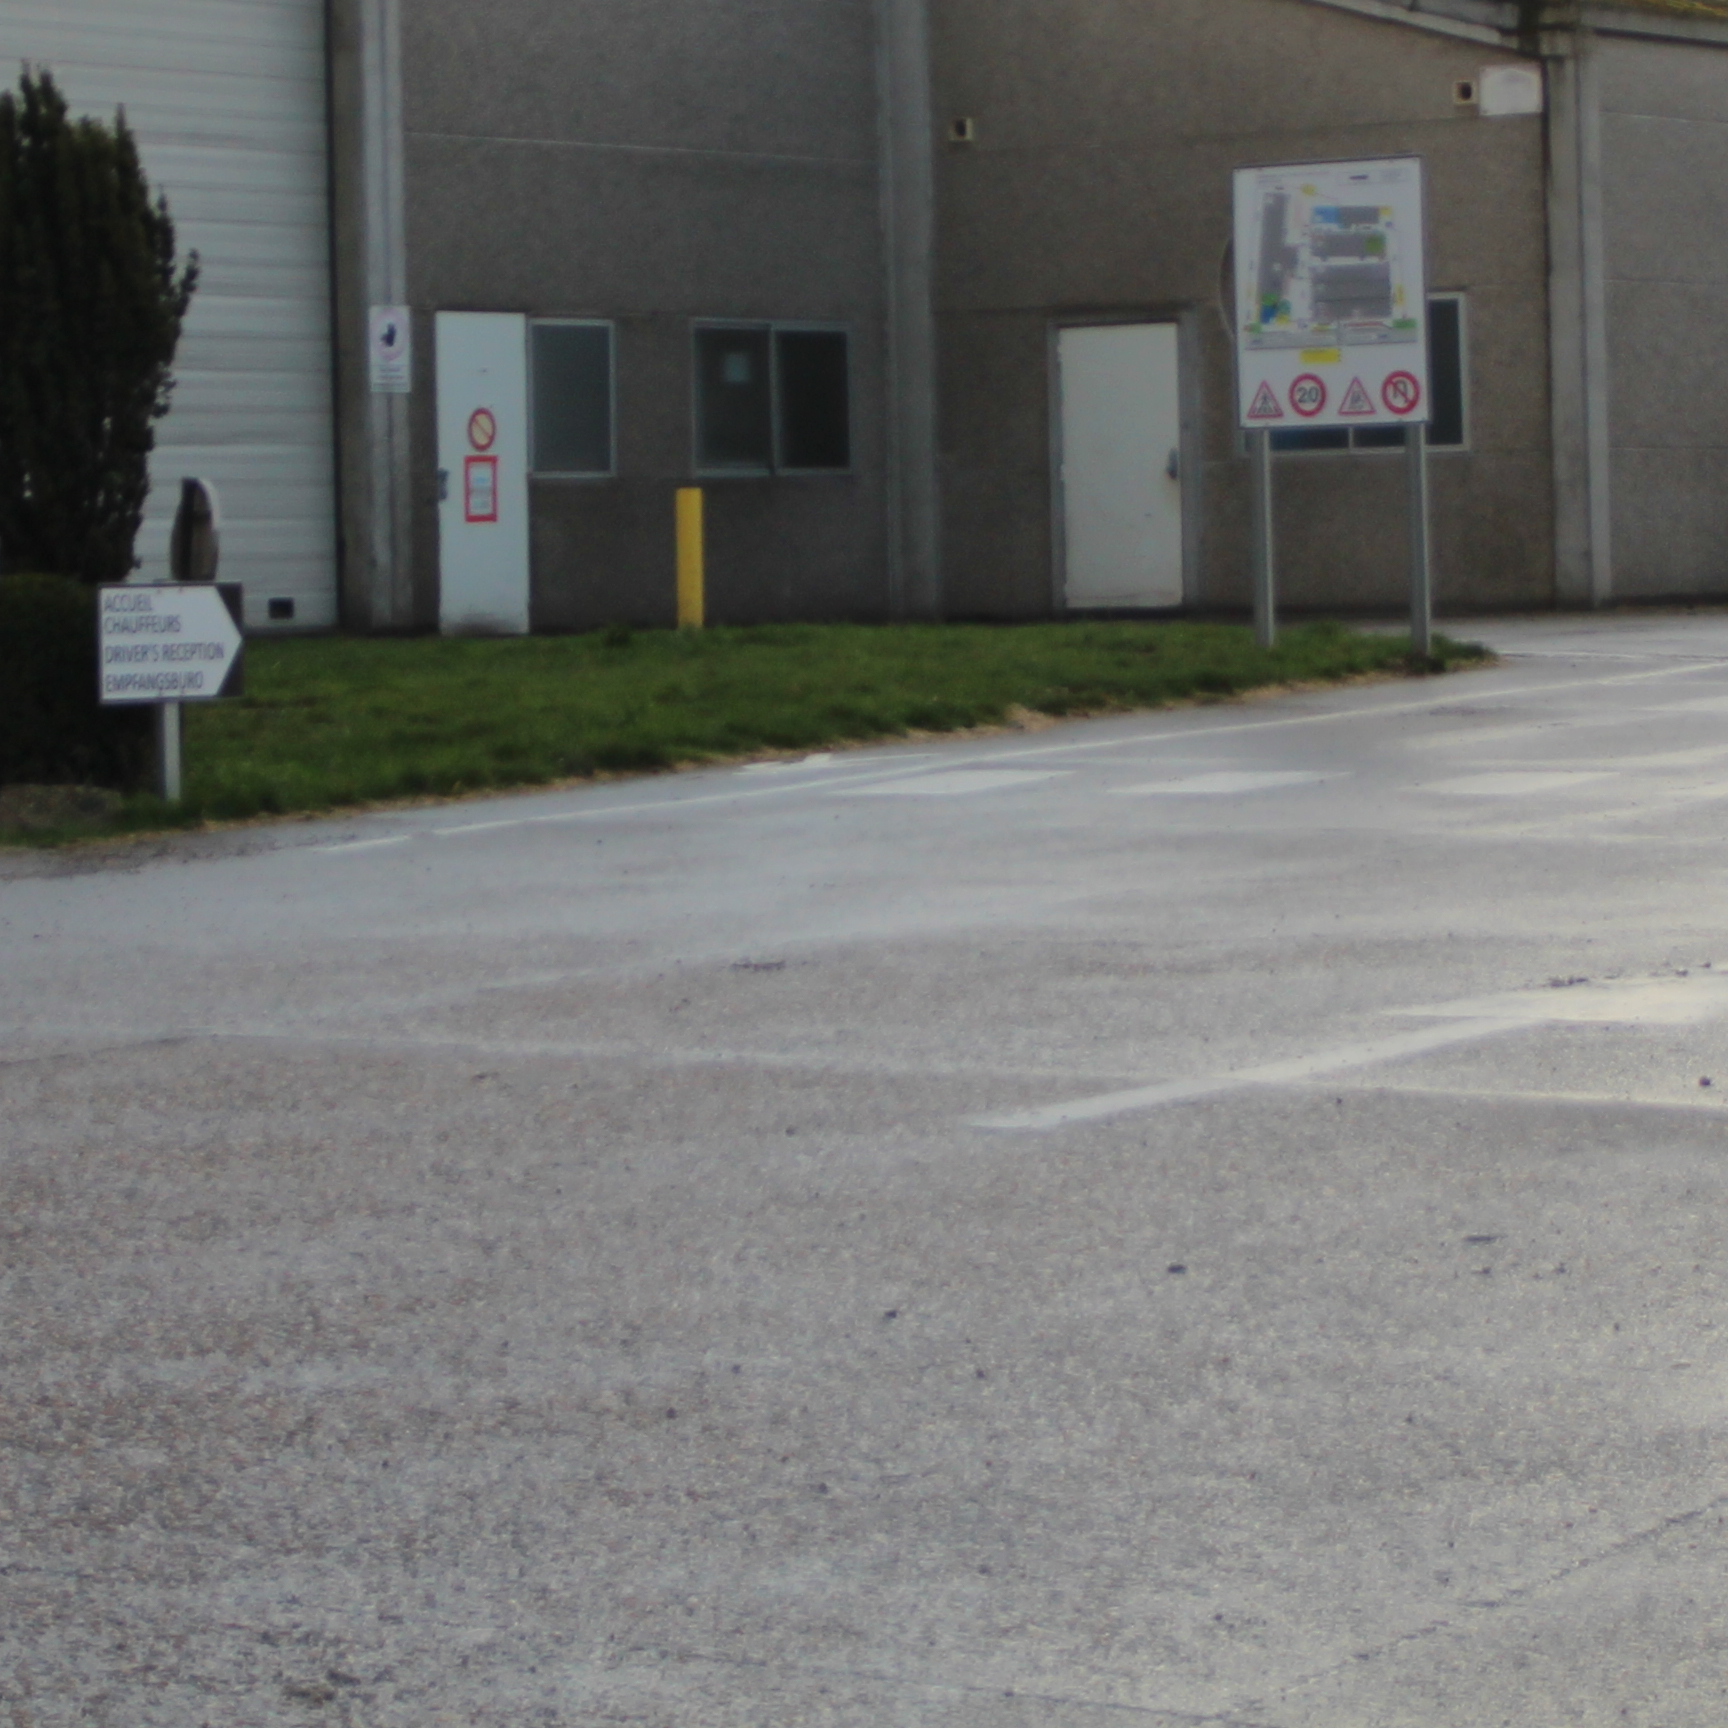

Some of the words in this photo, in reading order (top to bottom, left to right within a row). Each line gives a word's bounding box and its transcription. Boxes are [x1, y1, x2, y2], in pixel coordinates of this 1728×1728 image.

[1296, 385, 1320, 403] 20
[103, 594, 153, 612] ACCUEIL
[104, 615, 181, 634] CHAUFFEURS
[105, 645, 159, 664] DRIVER'S
[162, 642, 225, 662] RECEPTION
